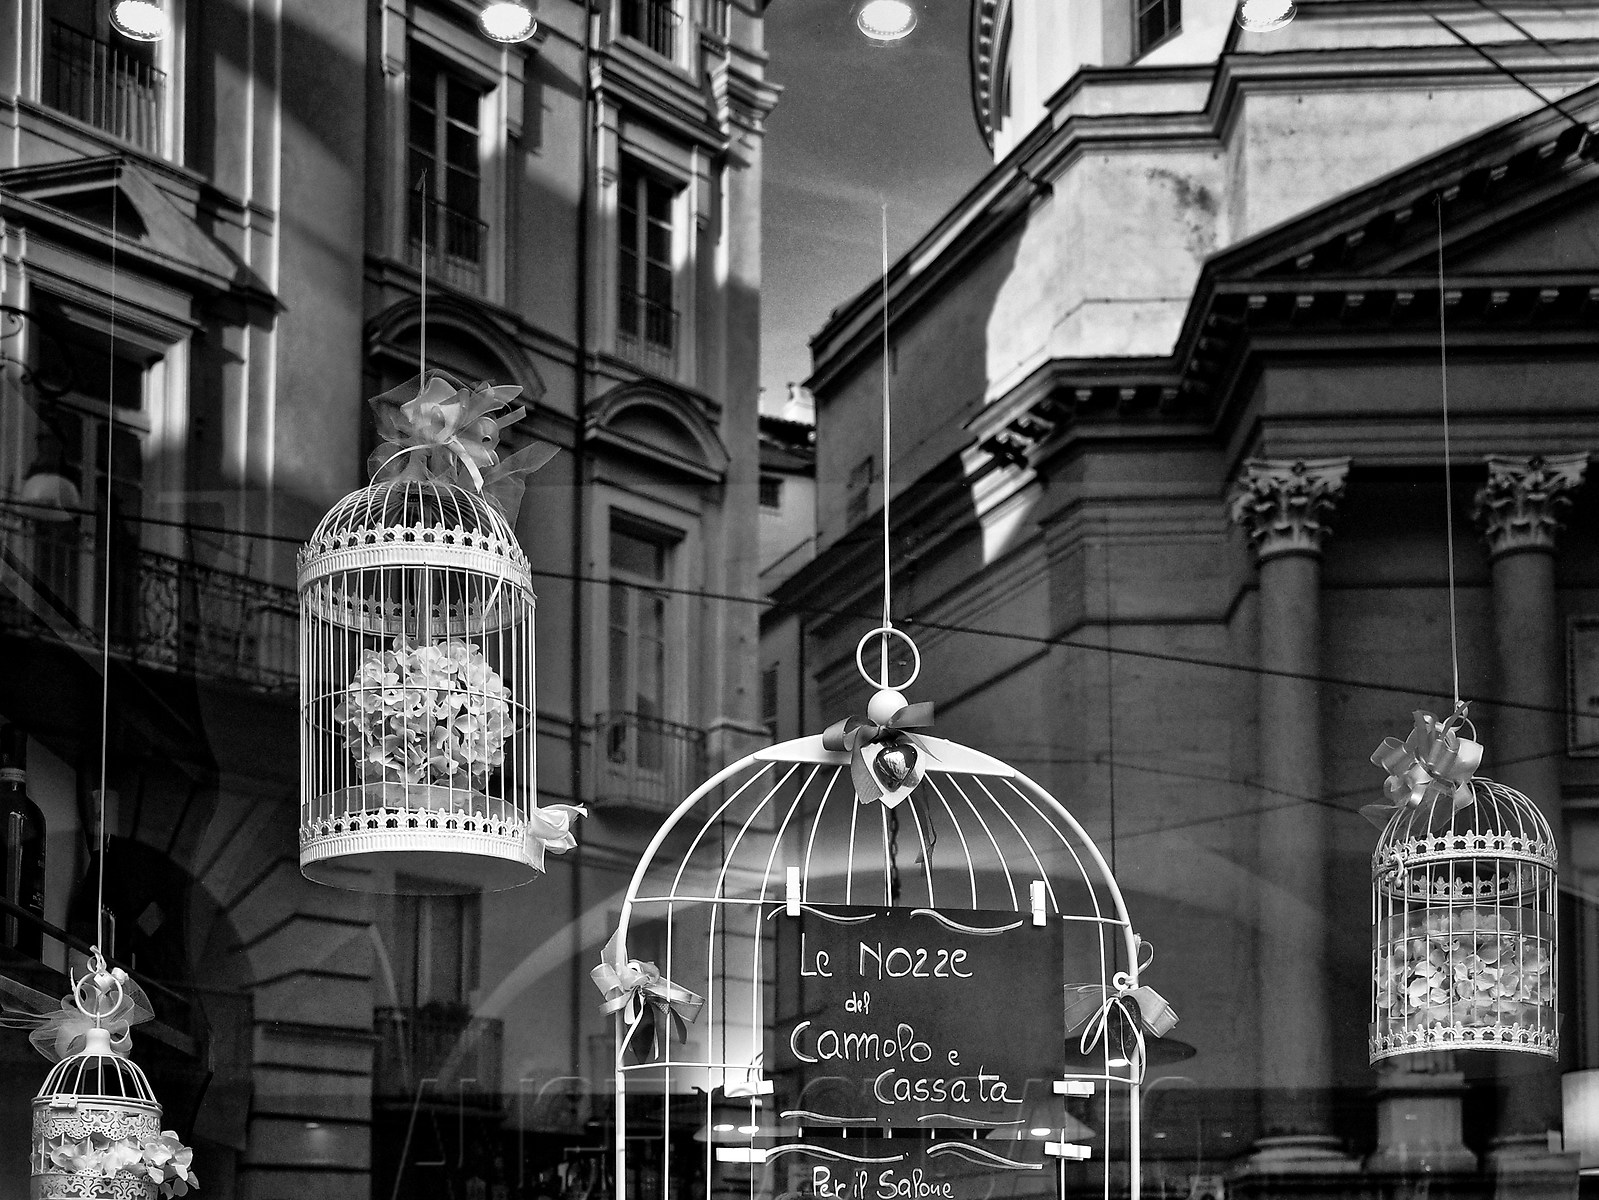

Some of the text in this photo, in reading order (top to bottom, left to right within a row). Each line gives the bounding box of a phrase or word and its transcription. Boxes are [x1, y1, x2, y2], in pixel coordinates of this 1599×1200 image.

[800, 932, 833, 977] Le
[844, 990, 871, 1015] del
[790, 1020, 960, 1066] Cannolo e
[873, 1064, 1024, 1105] Cassata
[813, 1165, 955, 1200] Per il Salone
